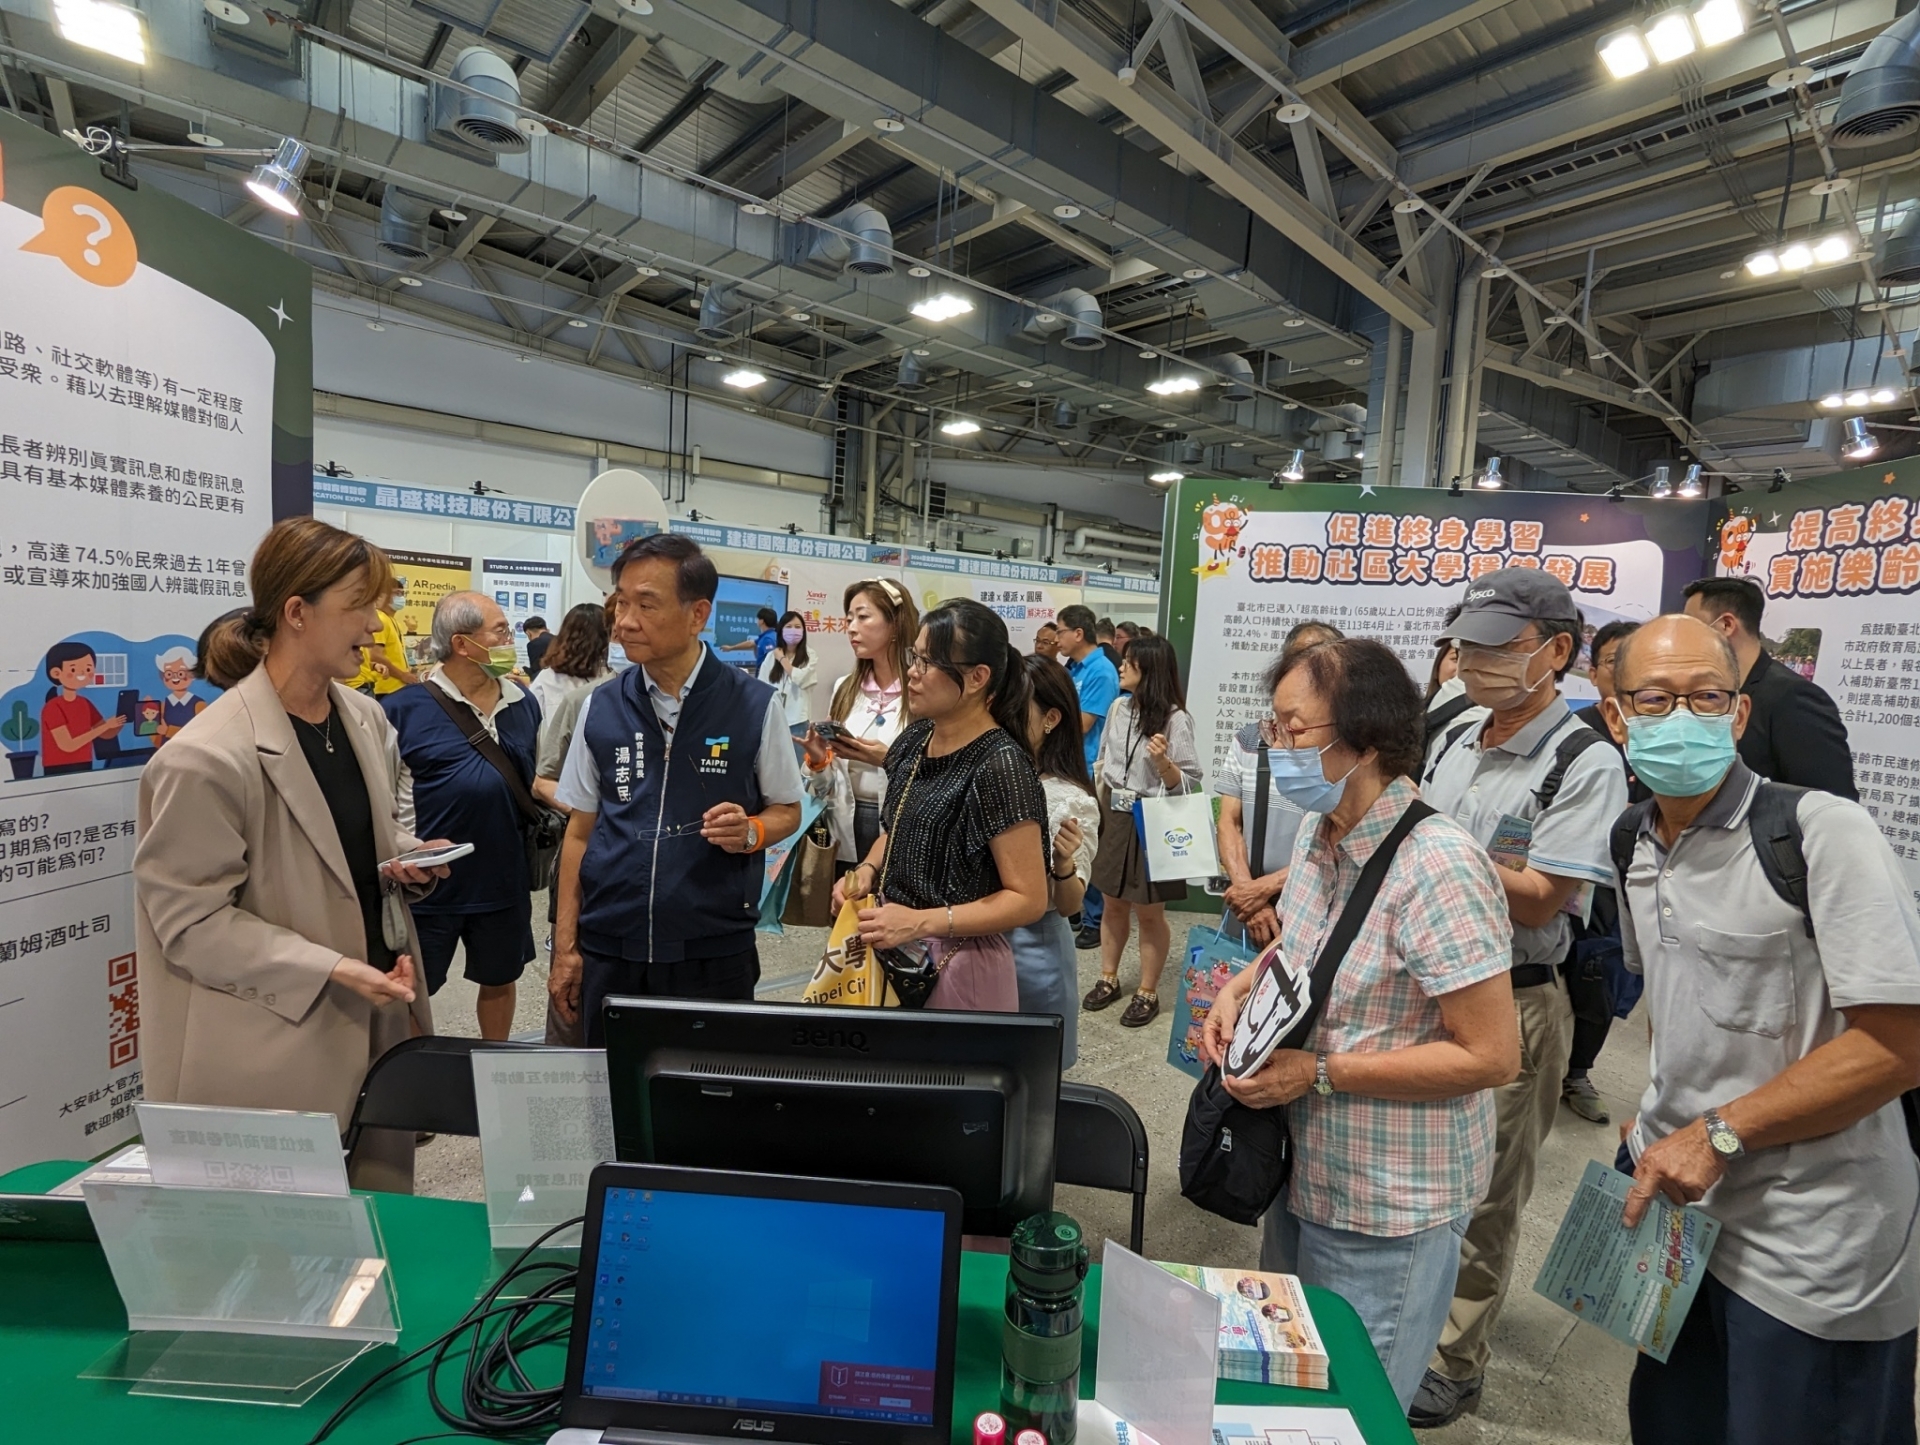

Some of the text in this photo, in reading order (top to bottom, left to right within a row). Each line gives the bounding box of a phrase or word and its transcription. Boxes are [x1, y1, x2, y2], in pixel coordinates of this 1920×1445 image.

[0, 331, 244, 416] 路、社交軟體等)有一定程度
[313, 492, 344, 501] CATION
[374, 486, 577, 528] 晶盛科技股份有限公
[1327, 513, 1543, 551] 促進終身學習
[726, 530, 868, 562] 建達國際股份有限公司
[0, 564, 248, 598] 或宣導來加強國人辨識假訊息
[958, 558, 1058, 583] 建達國際股份有限公司
[1466, 588, 1496, 602] Sysco
[1225, 641, 1283, 653] ，推動全民終
[1399, 648, 1440, 660] 是當今重
[1231, 671, 1265, 681] 本市於
[1216, 720, 1252, 731] 發展公
[614, 746, 632, 802] 湯志民
[700, 758, 728, 767] TAIPEI
[1889, 842, 1919, 861] 得主
[813, 933, 867, 981] 大學
[801, 977, 866, 1005] aipei Cit
[1191, 996, 1212, 1008] TAIP
[791, 1025, 870, 1053] BenQ
[59, 1070, 144, 1118] 大安社大官方
[731, 1417, 775, 1433] ASUS
